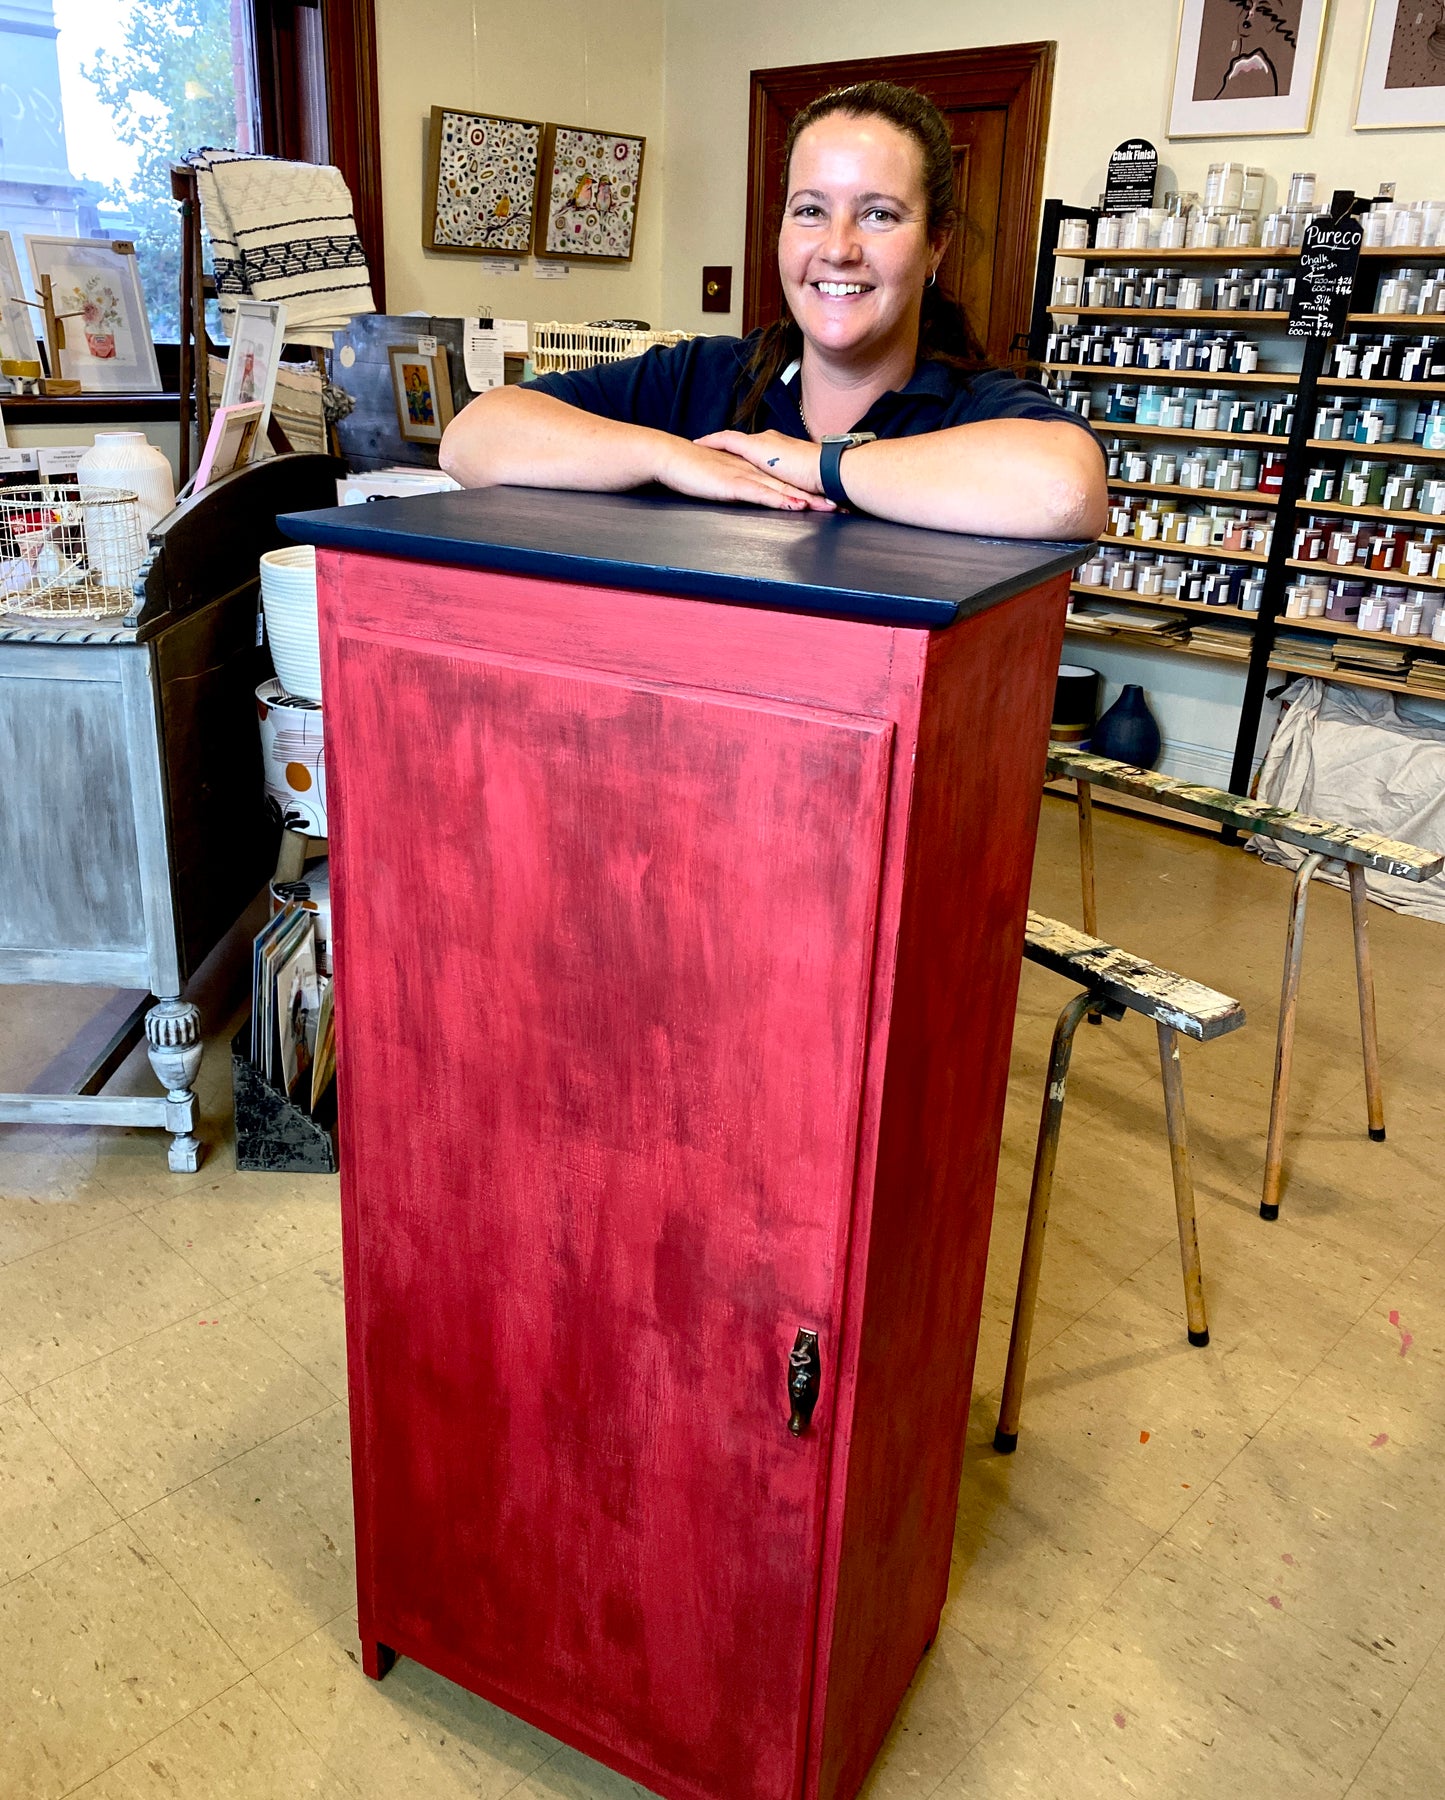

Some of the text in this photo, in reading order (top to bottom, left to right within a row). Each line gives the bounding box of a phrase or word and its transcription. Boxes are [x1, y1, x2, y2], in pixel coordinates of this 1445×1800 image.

[1112, 149, 1156, 161] Chalk Finish
[1306, 225, 1362, 245] Pureco
[1300, 254, 1329, 266] Chalk
[1311, 262, 1338, 273] Finish
[1314, 294, 1332, 306] Silk
[1299, 302, 1329, 312] Finish
